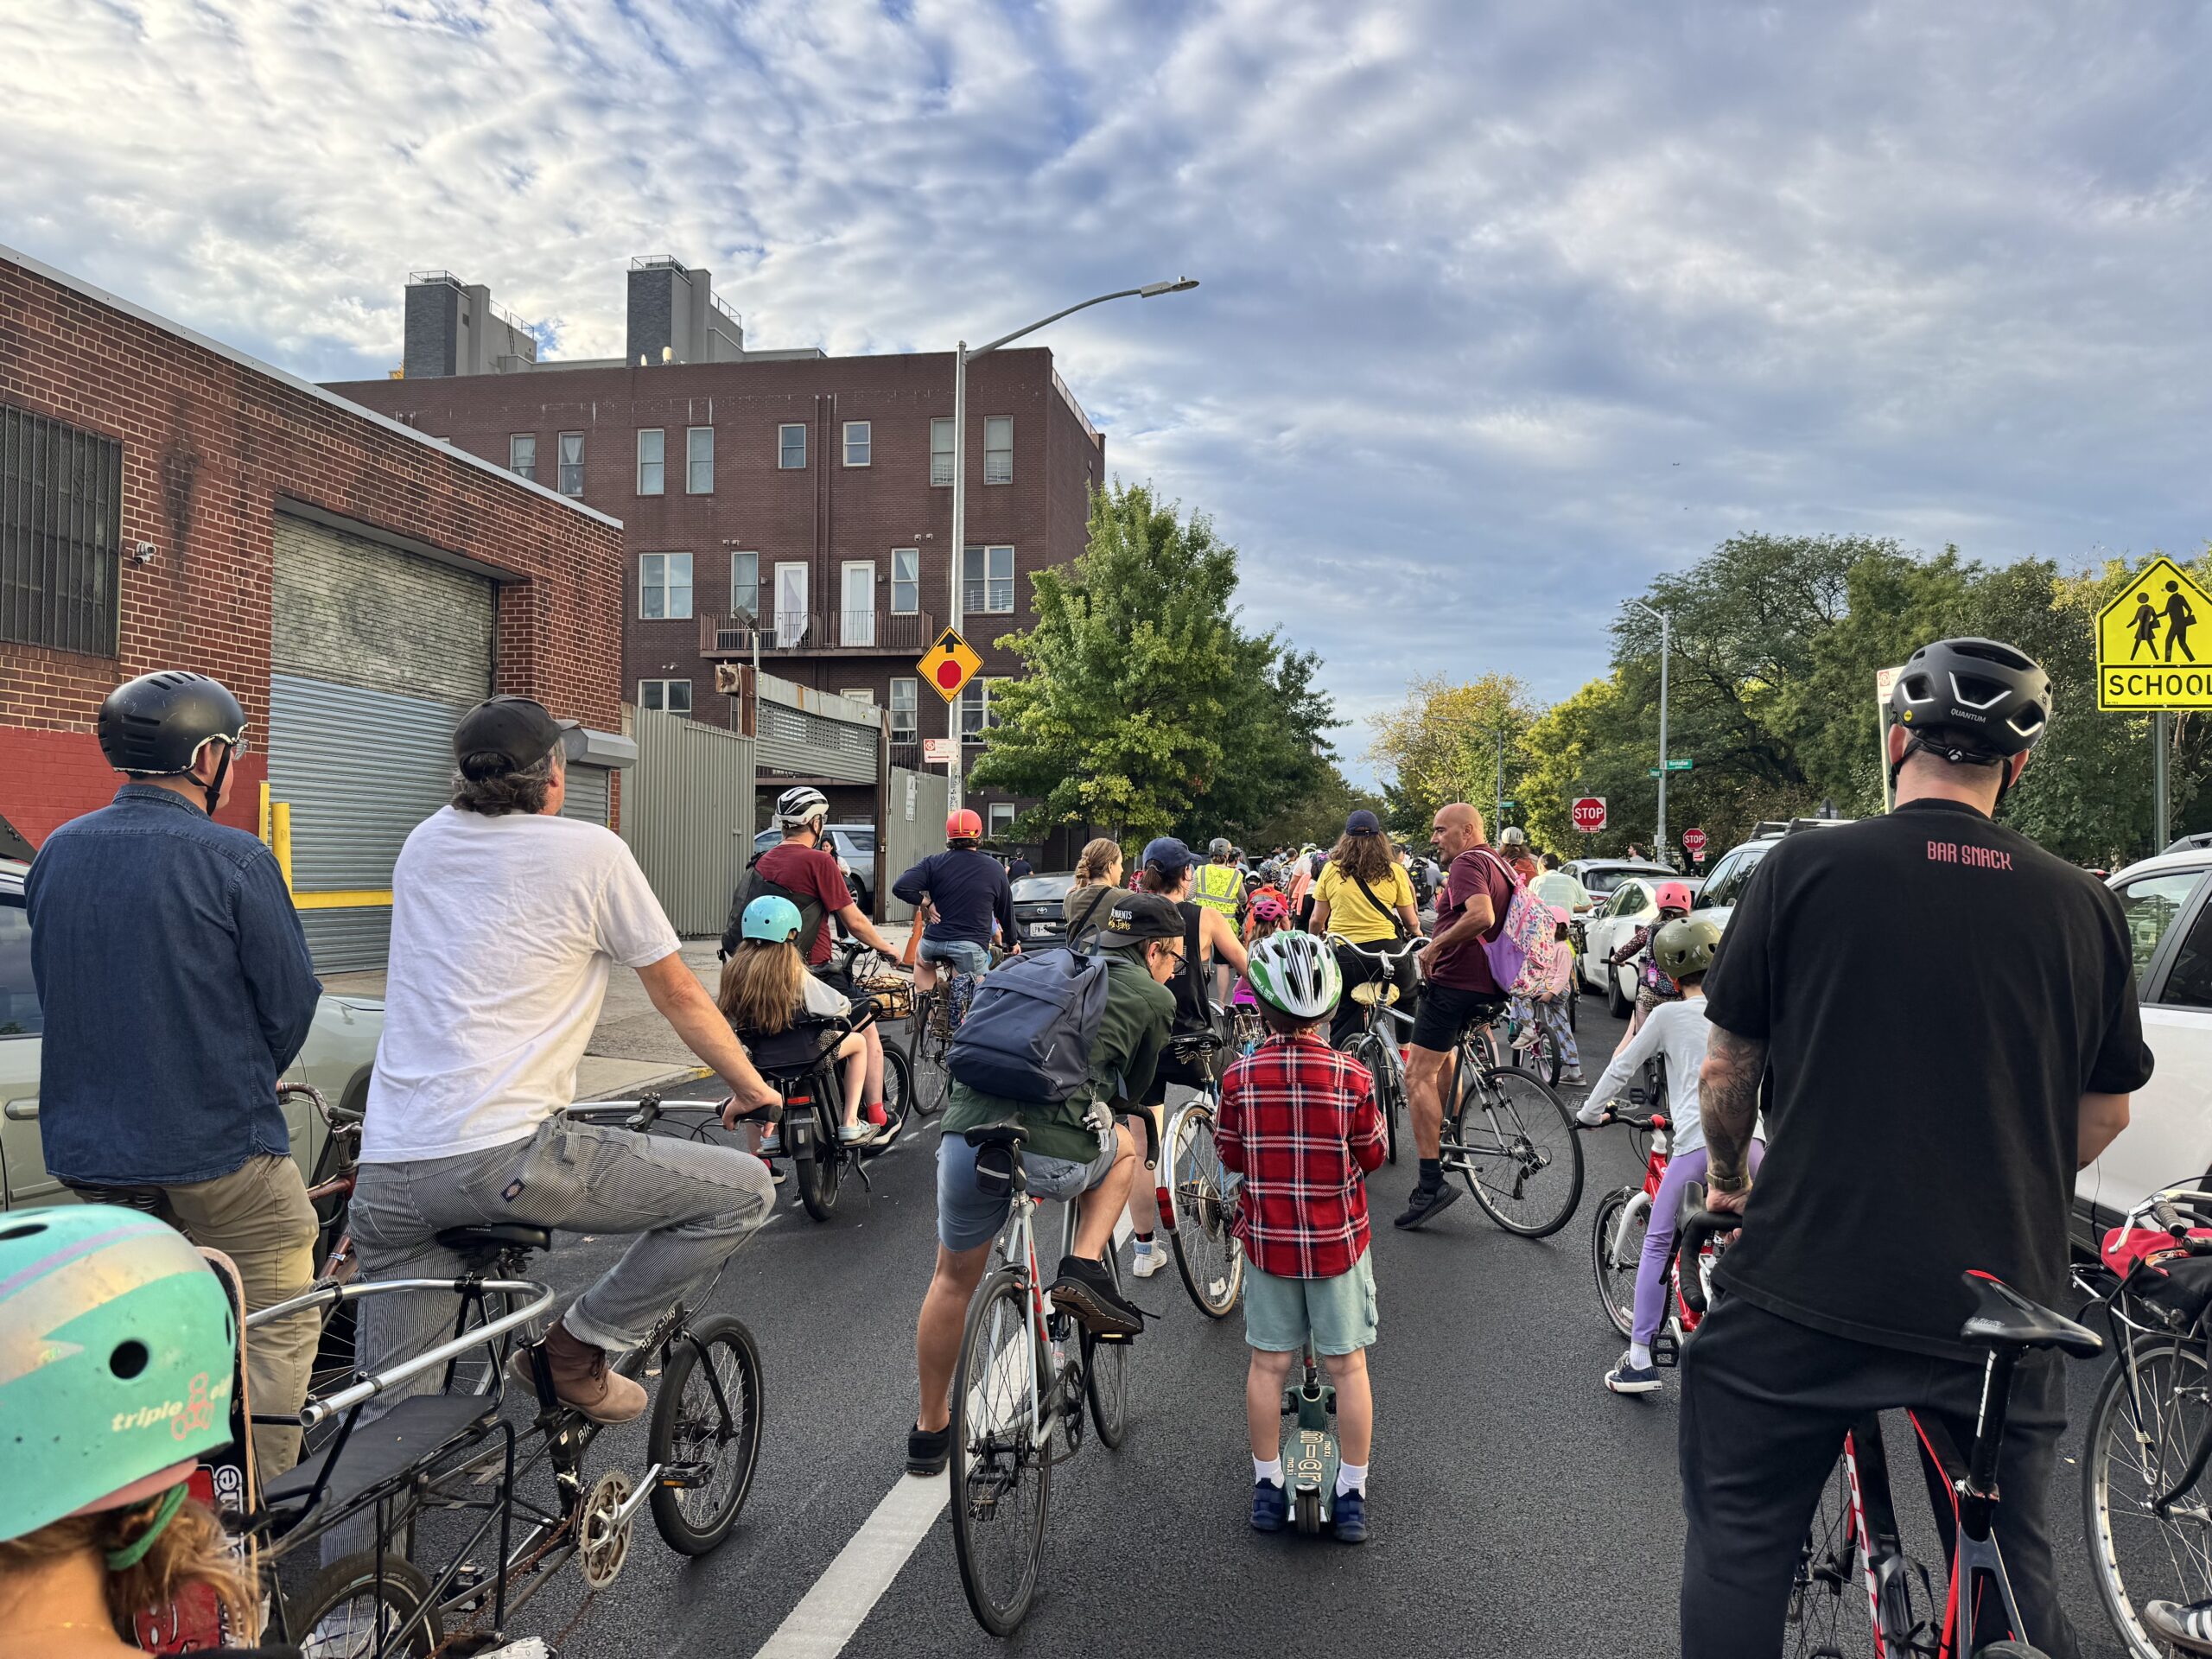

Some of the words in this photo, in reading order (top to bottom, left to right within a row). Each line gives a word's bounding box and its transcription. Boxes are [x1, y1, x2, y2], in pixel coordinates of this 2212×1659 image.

[1950, 708, 1986, 724] QUANTUM
[1574, 807, 1604, 819] STOP
[1685, 835, 1704, 843] STOP
[1927, 841, 1957, 863] BAR
[1961, 845, 2013, 871] SNACK
[111, 1400, 183, 1433] triple
[1324, 1440, 1334, 1458] maxi
[1287, 1457, 1297, 1476] maxi
